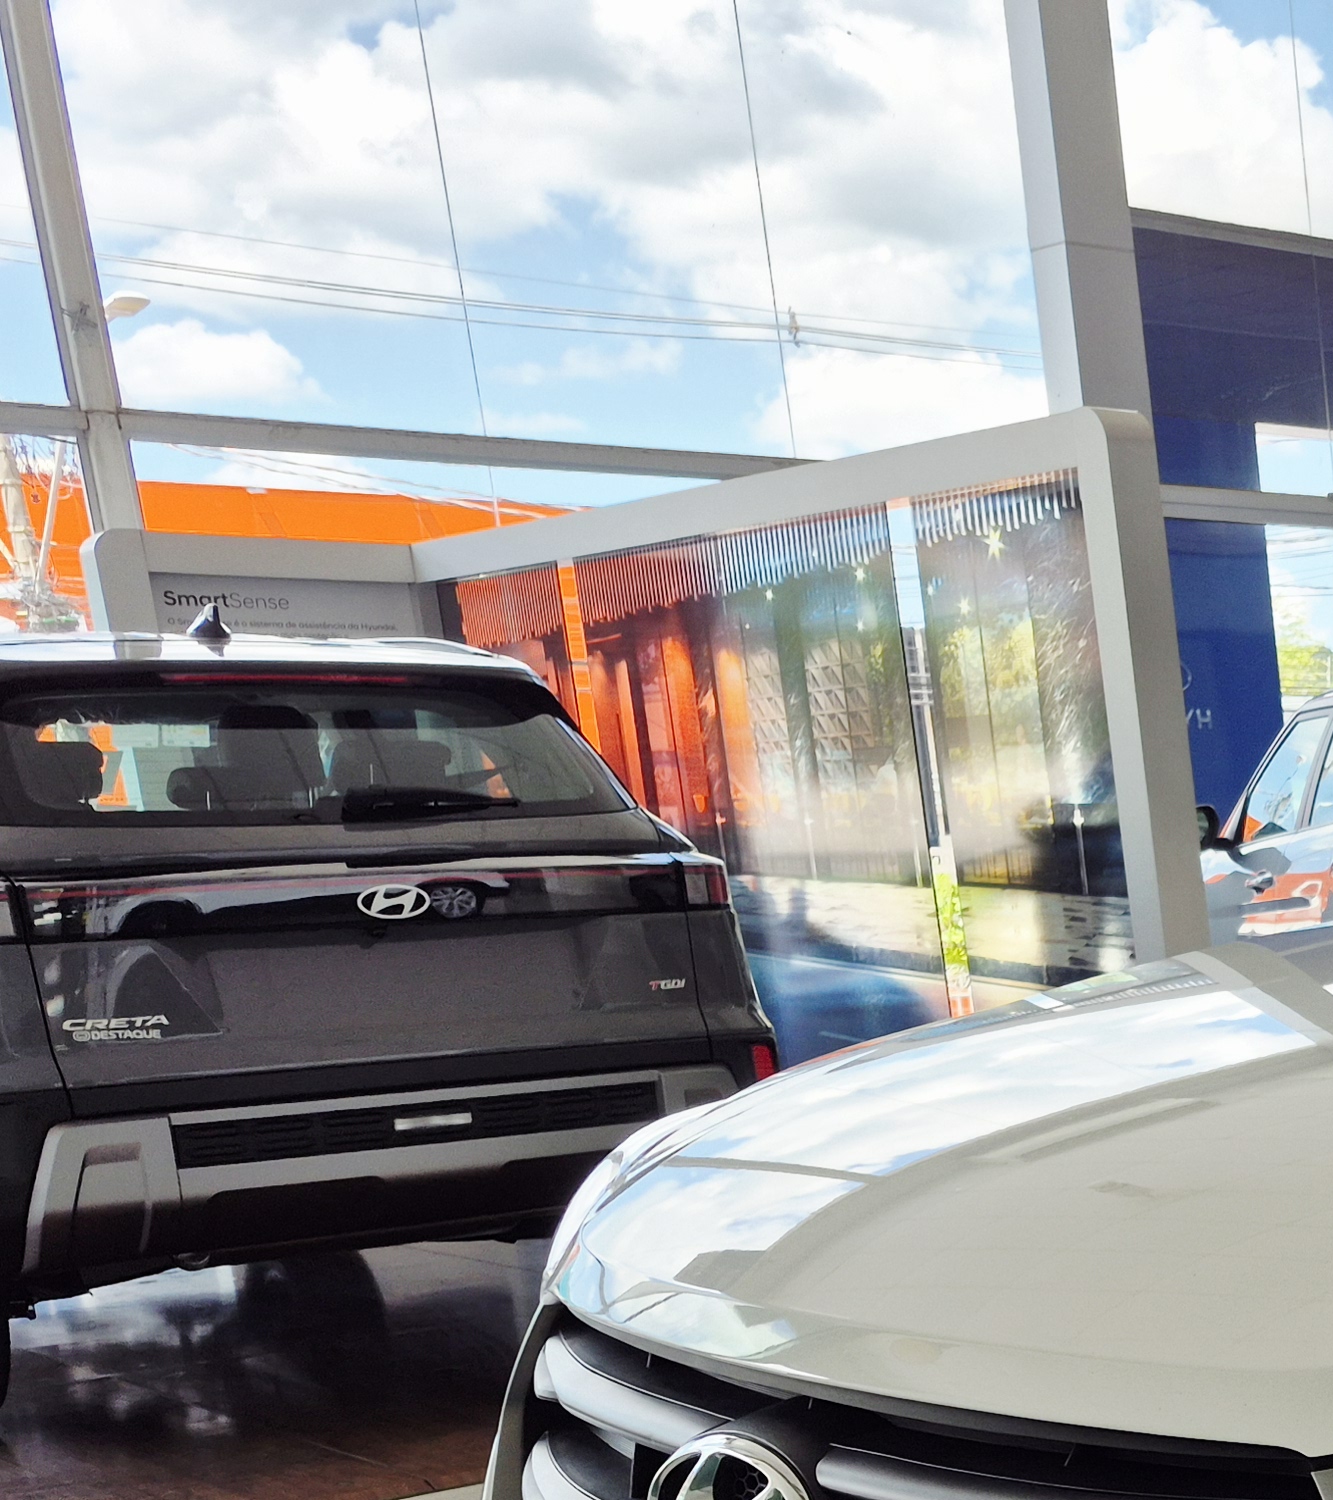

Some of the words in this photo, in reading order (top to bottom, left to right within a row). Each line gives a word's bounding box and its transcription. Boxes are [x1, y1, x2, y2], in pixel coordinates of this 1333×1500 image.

[163, 589, 290, 611] SmartSense
[62, 1014, 170, 1031] CRETA
[91, 1029, 162, 1040] DESTAQUE
